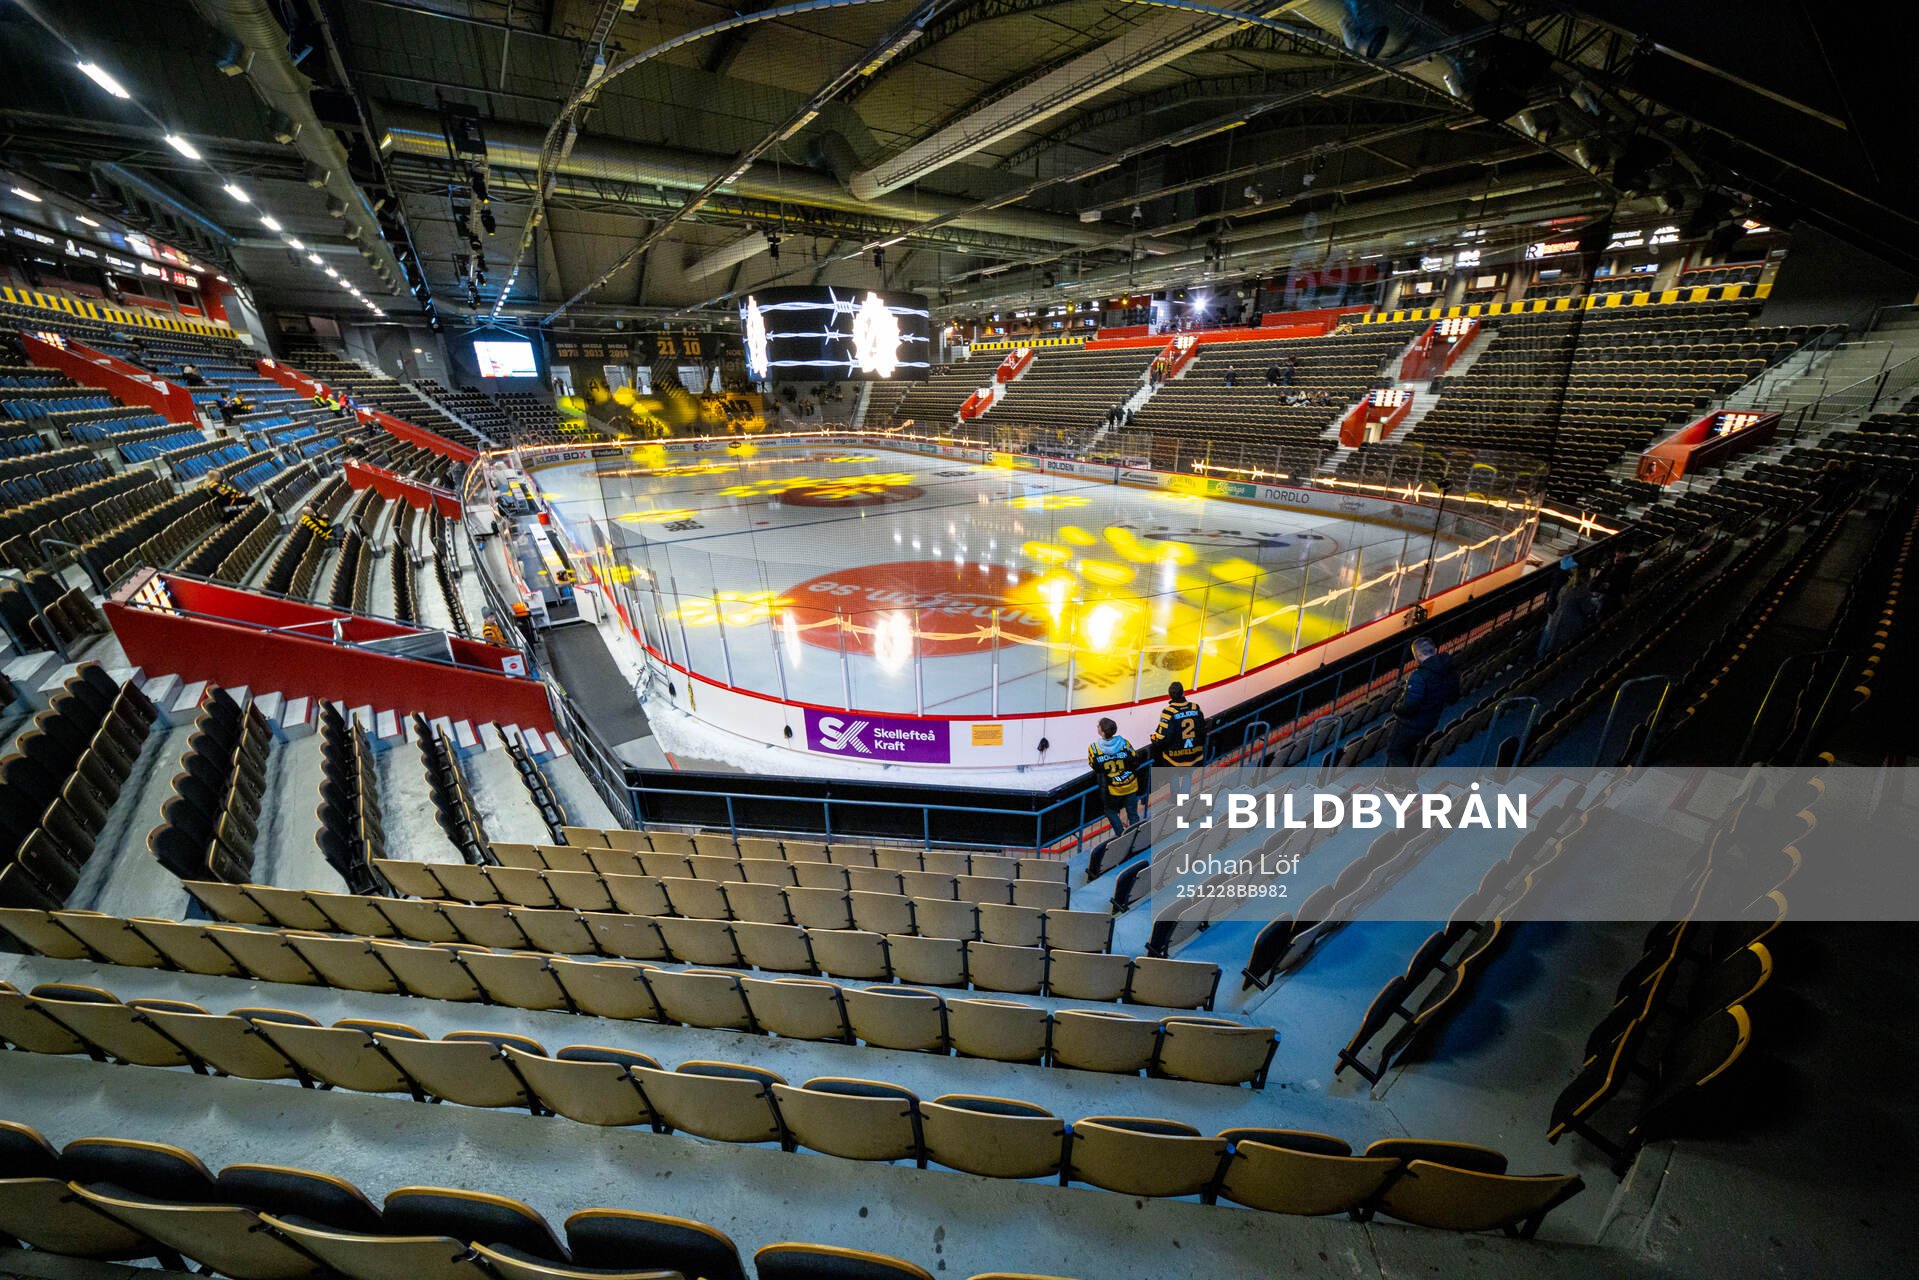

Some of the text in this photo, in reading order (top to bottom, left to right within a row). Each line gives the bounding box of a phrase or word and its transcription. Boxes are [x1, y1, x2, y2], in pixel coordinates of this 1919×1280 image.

[657, 341, 675, 355] 21
[683, 341, 701, 355] 10
[424, 351, 434, 363] E
[873, 728, 936, 742] Skellefteå
[1181, 718, 1196, 740] 2
[874, 740, 906, 752] Kraft
